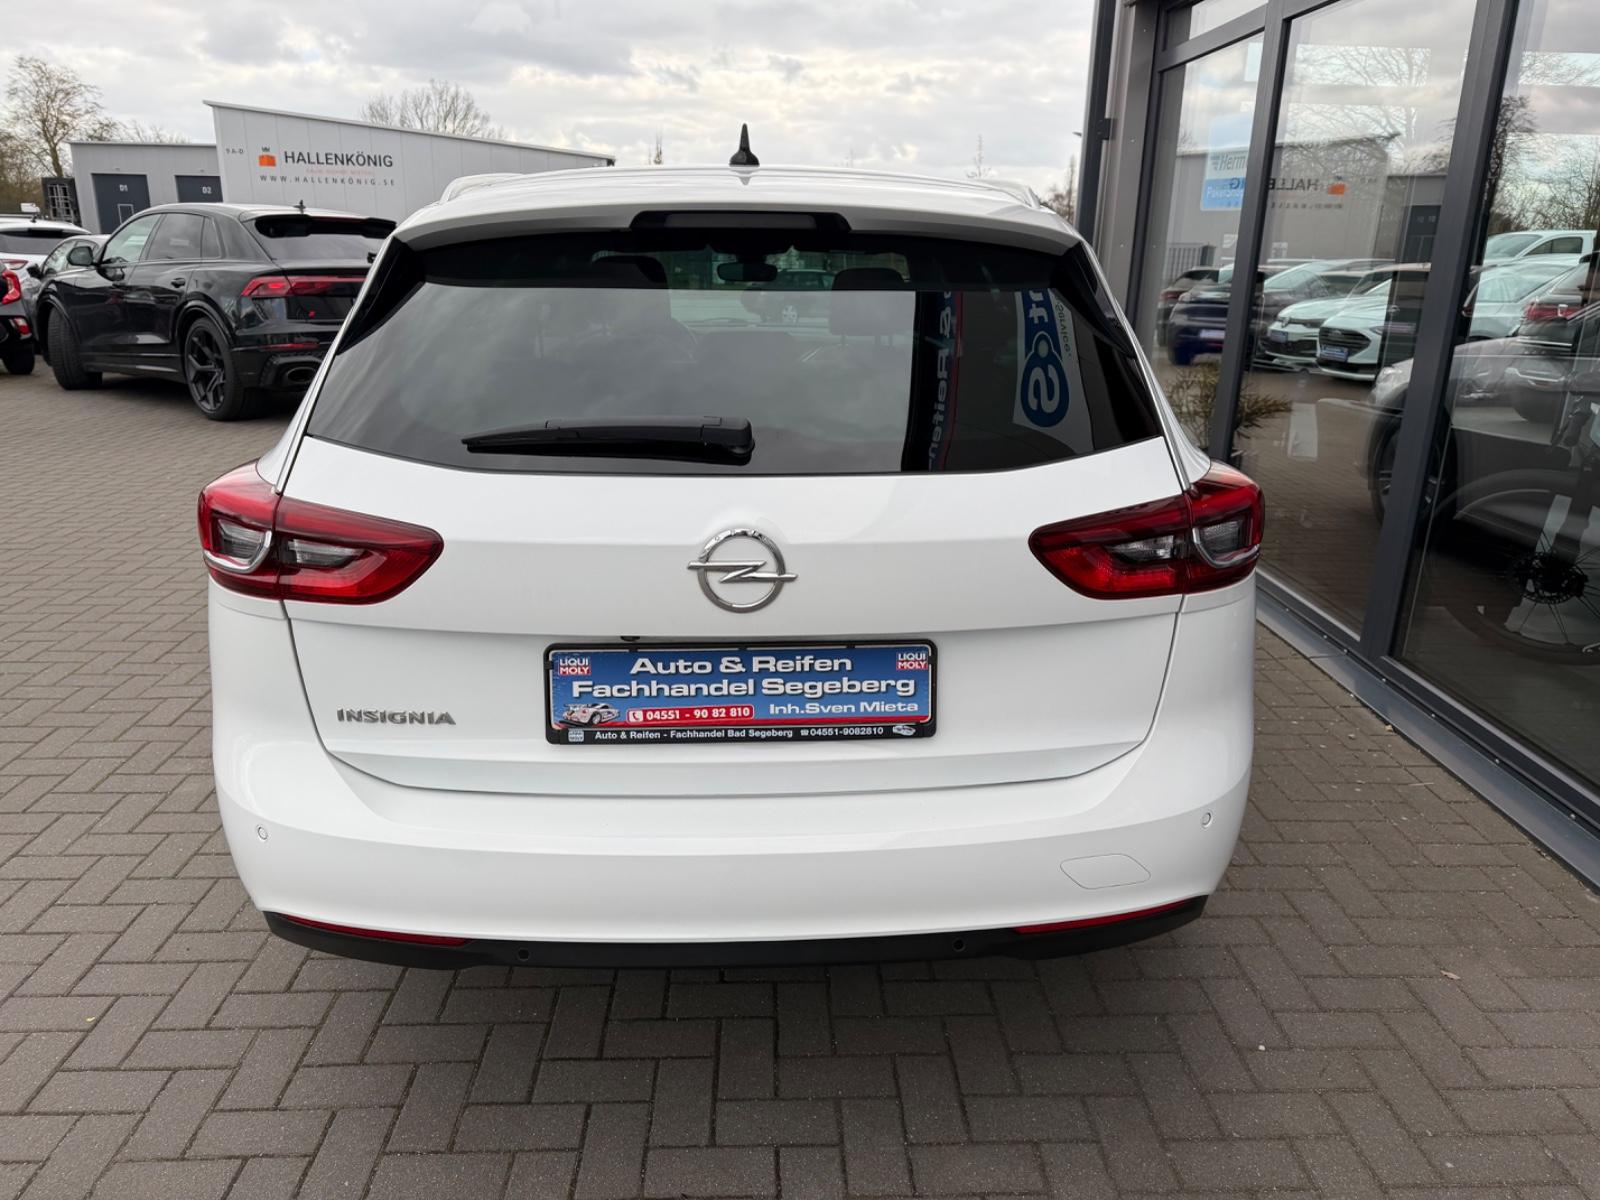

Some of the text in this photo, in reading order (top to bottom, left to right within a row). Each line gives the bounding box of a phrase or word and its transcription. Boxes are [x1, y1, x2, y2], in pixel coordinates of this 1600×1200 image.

[284, 150, 393, 168] HALLENKÖNIG
[1219, 154, 1247, 171] Herm
[559, 657, 590, 667] LIQUI
[630, 654, 853, 674] Auto & Reifen
[898, 652, 927, 662] LIQUI
[559, 666, 591, 674] MOLY
[897, 661, 928, 669] MOLY
[573, 677, 915, 698] Fachhandel Segeberg
[859, 700, 919, 713] Mieta
[337, 708, 457, 725] INSIGNIA
[646, 710, 681, 722] 04551
[694, 709, 708, 720] 90
[712, 708, 726, 719] 82
[729, 707, 751, 718] 810
[595, 731, 618, 740] Auto
[619, 731, 629, 739] &
[630, 730, 661, 739] Reifen
[670, 729, 726, 739] Fachhandel
[728, 728, 746, 738] Bad
[748, 728, 794, 740] Segeberg
[810, 726, 885, 737] 04551-9082810
